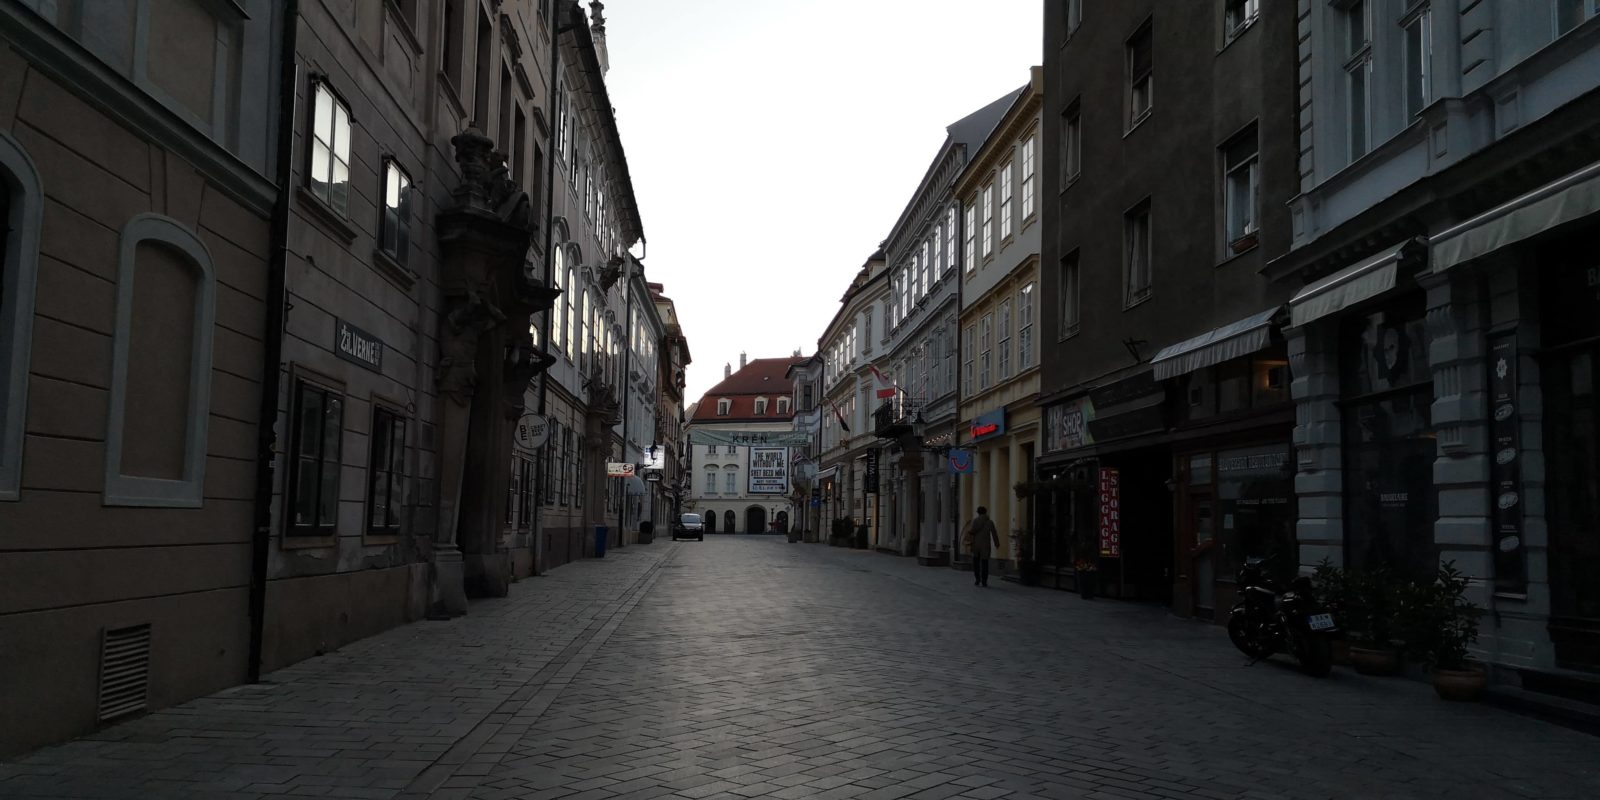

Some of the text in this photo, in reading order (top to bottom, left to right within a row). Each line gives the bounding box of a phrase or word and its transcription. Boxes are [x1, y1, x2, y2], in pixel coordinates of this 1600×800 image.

[353, 331, 375, 364] VERNE
[1063, 412, 1082, 436] SHOP
[753, 460, 785, 468] WITHOUT ME
[755, 452, 783, 460] THE WORLD
[1101, 470, 1109, 549] LUGGAGE
[1110, 476, 1119, 555] STORAGE
